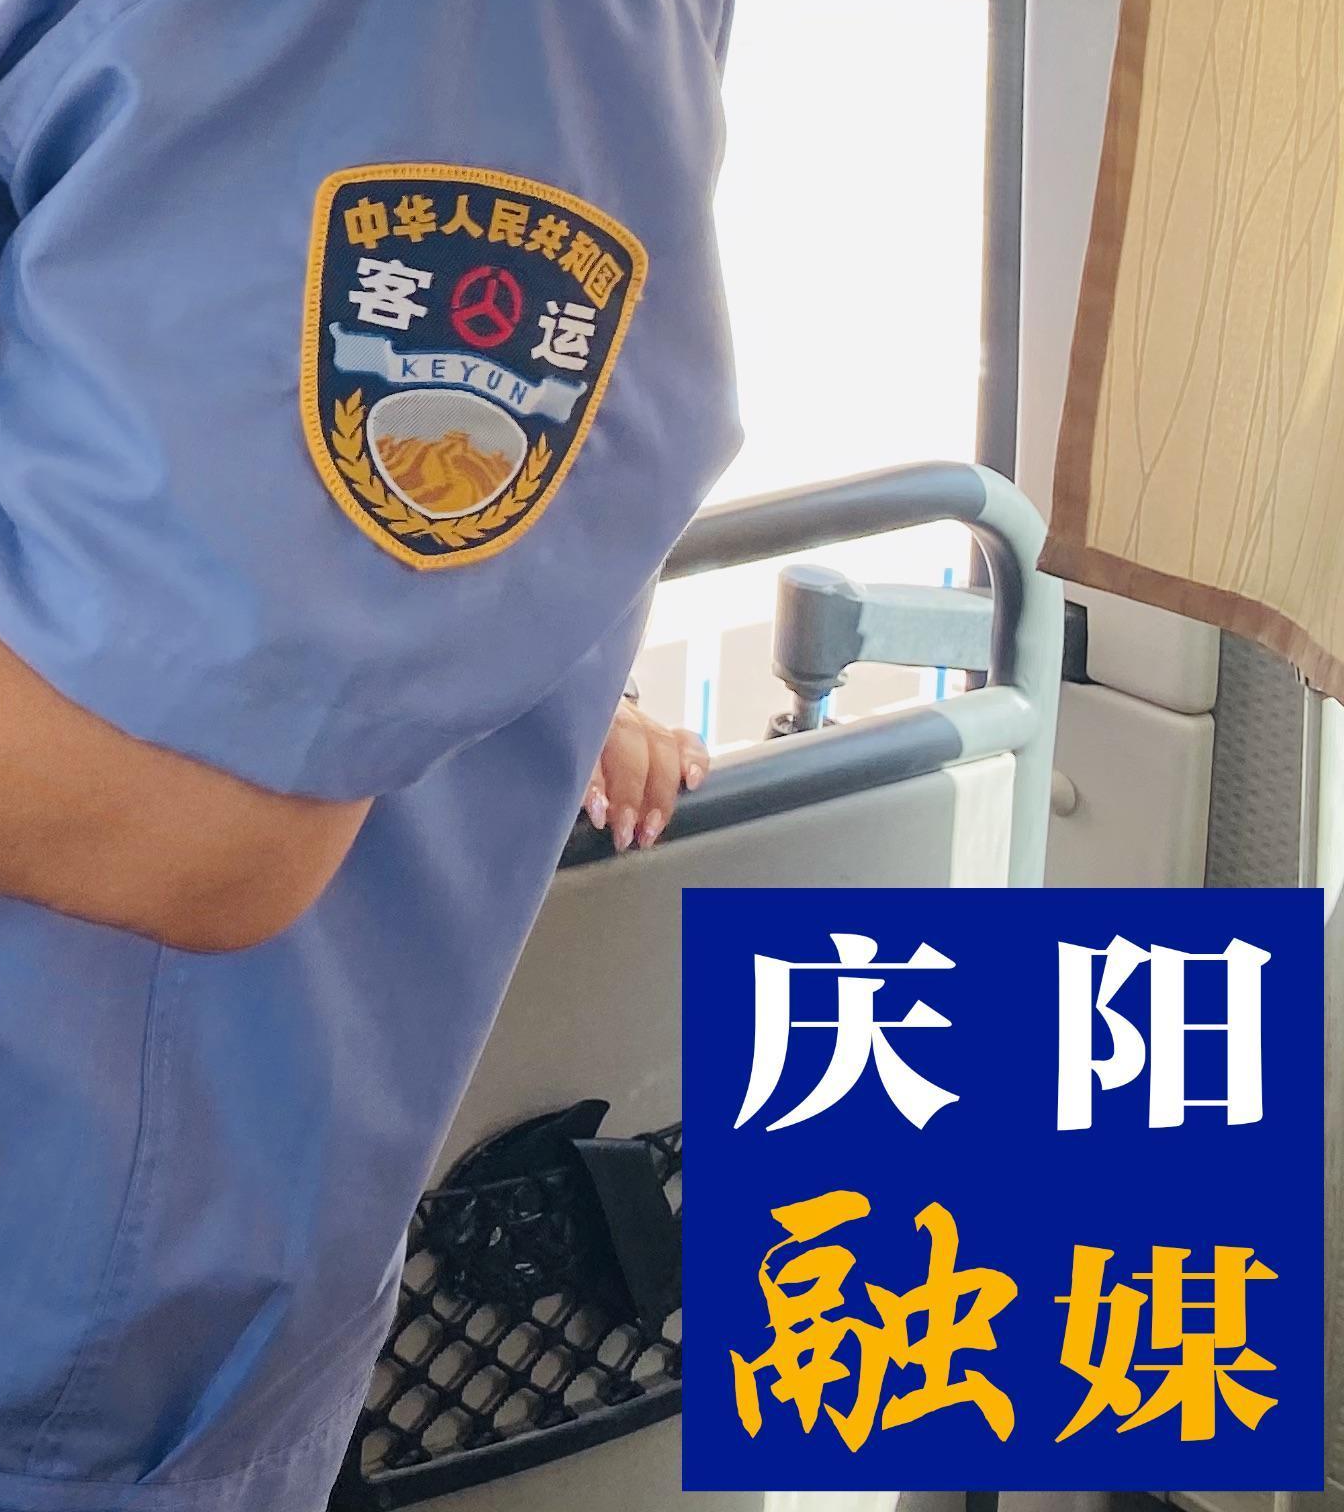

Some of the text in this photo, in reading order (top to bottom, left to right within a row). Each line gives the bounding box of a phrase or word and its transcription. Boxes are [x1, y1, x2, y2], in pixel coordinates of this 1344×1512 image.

[343, 193, 625, 310] 中华人民共和国
[401, 357, 529, 406] KEYUN
